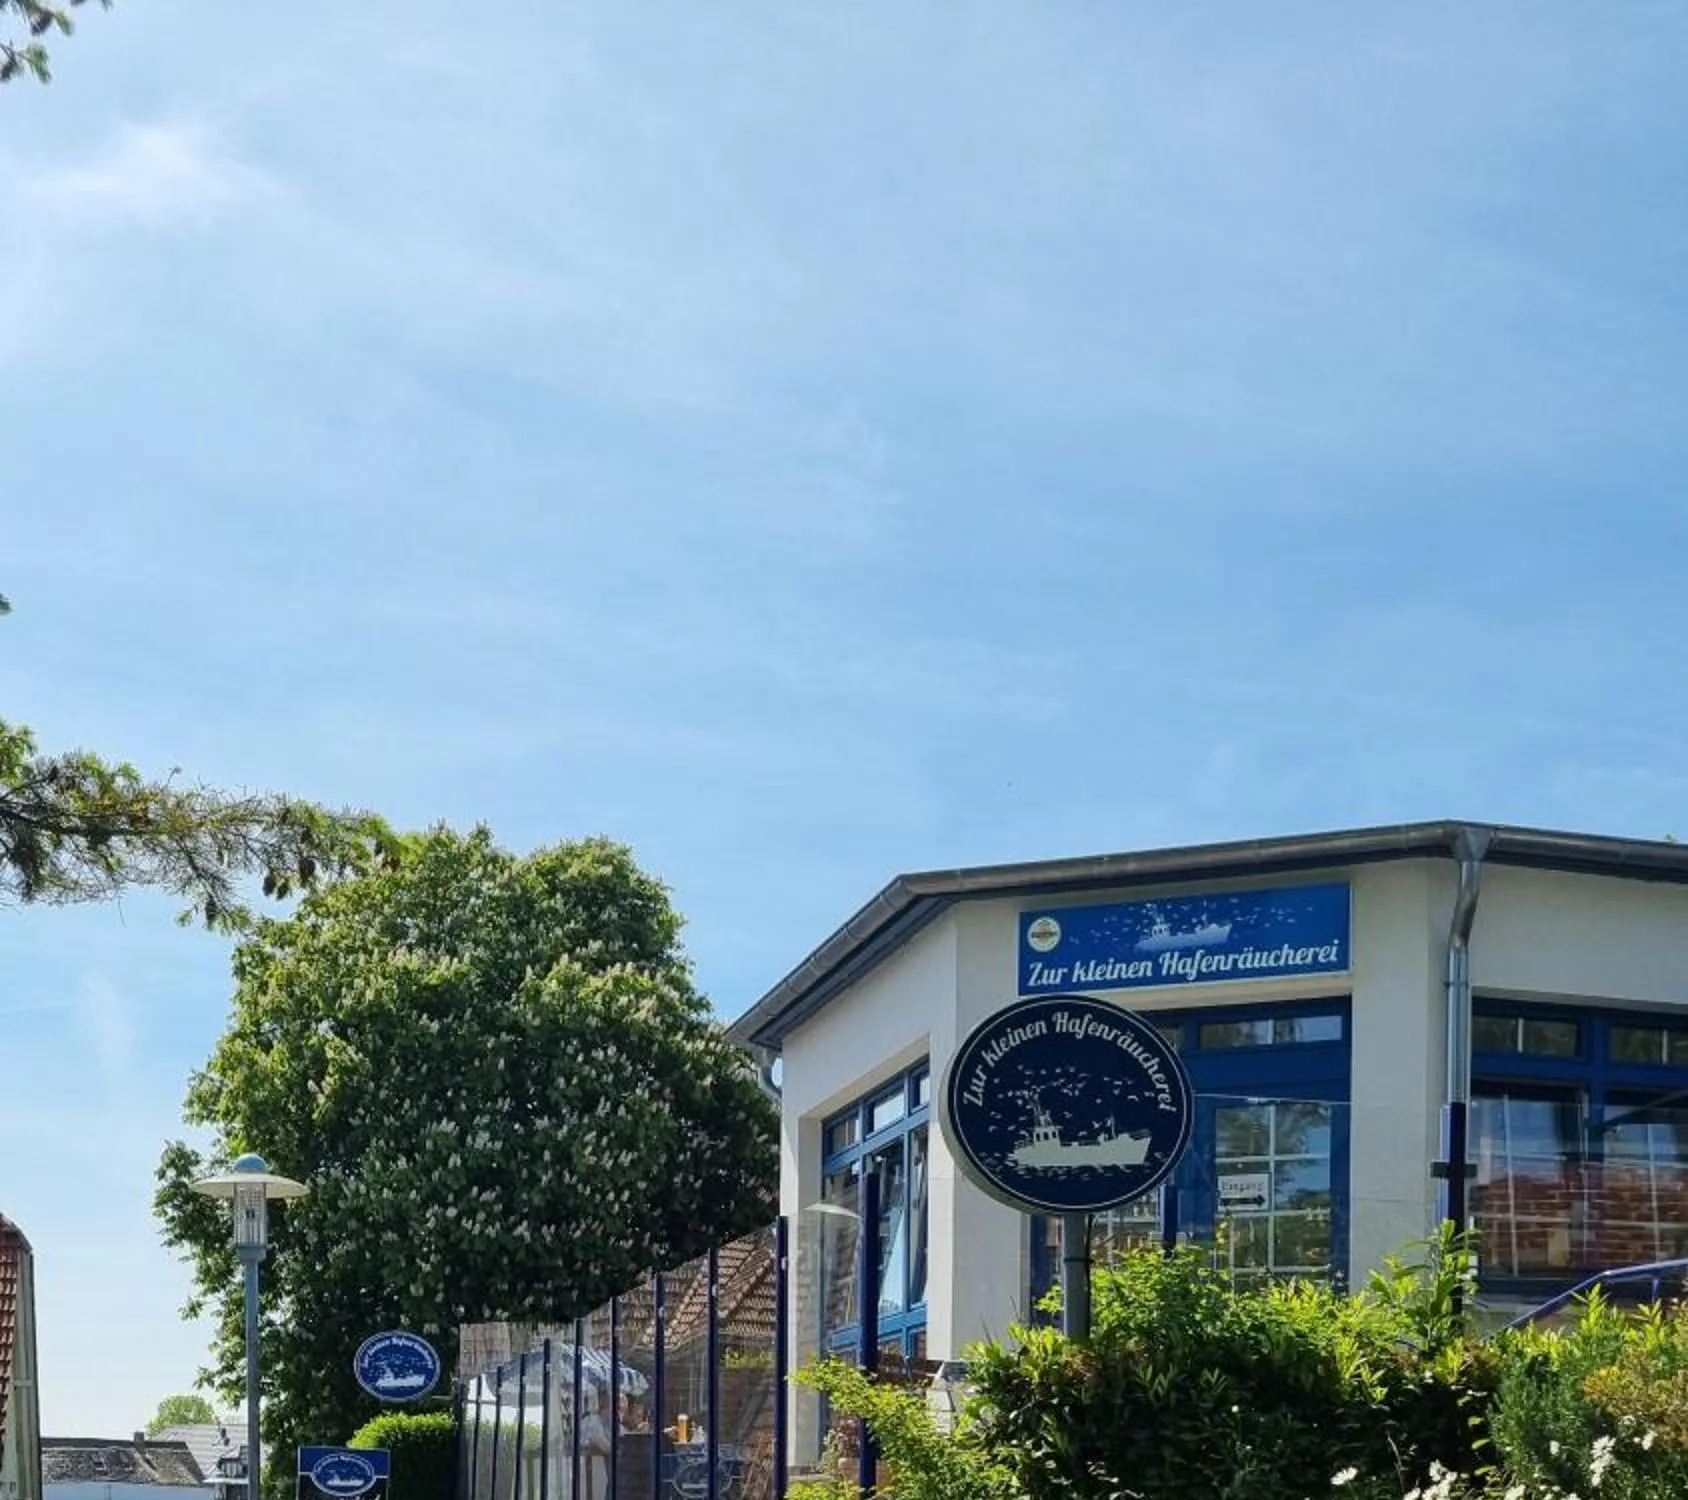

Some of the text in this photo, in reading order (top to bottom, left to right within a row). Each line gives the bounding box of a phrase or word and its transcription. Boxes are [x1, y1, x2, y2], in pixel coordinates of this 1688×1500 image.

[1027, 938, 1340, 987] Zur kleinen Hafenräucherei
[963, 1011, 1177, 1113] Zur kleinen Hafenräucherei
